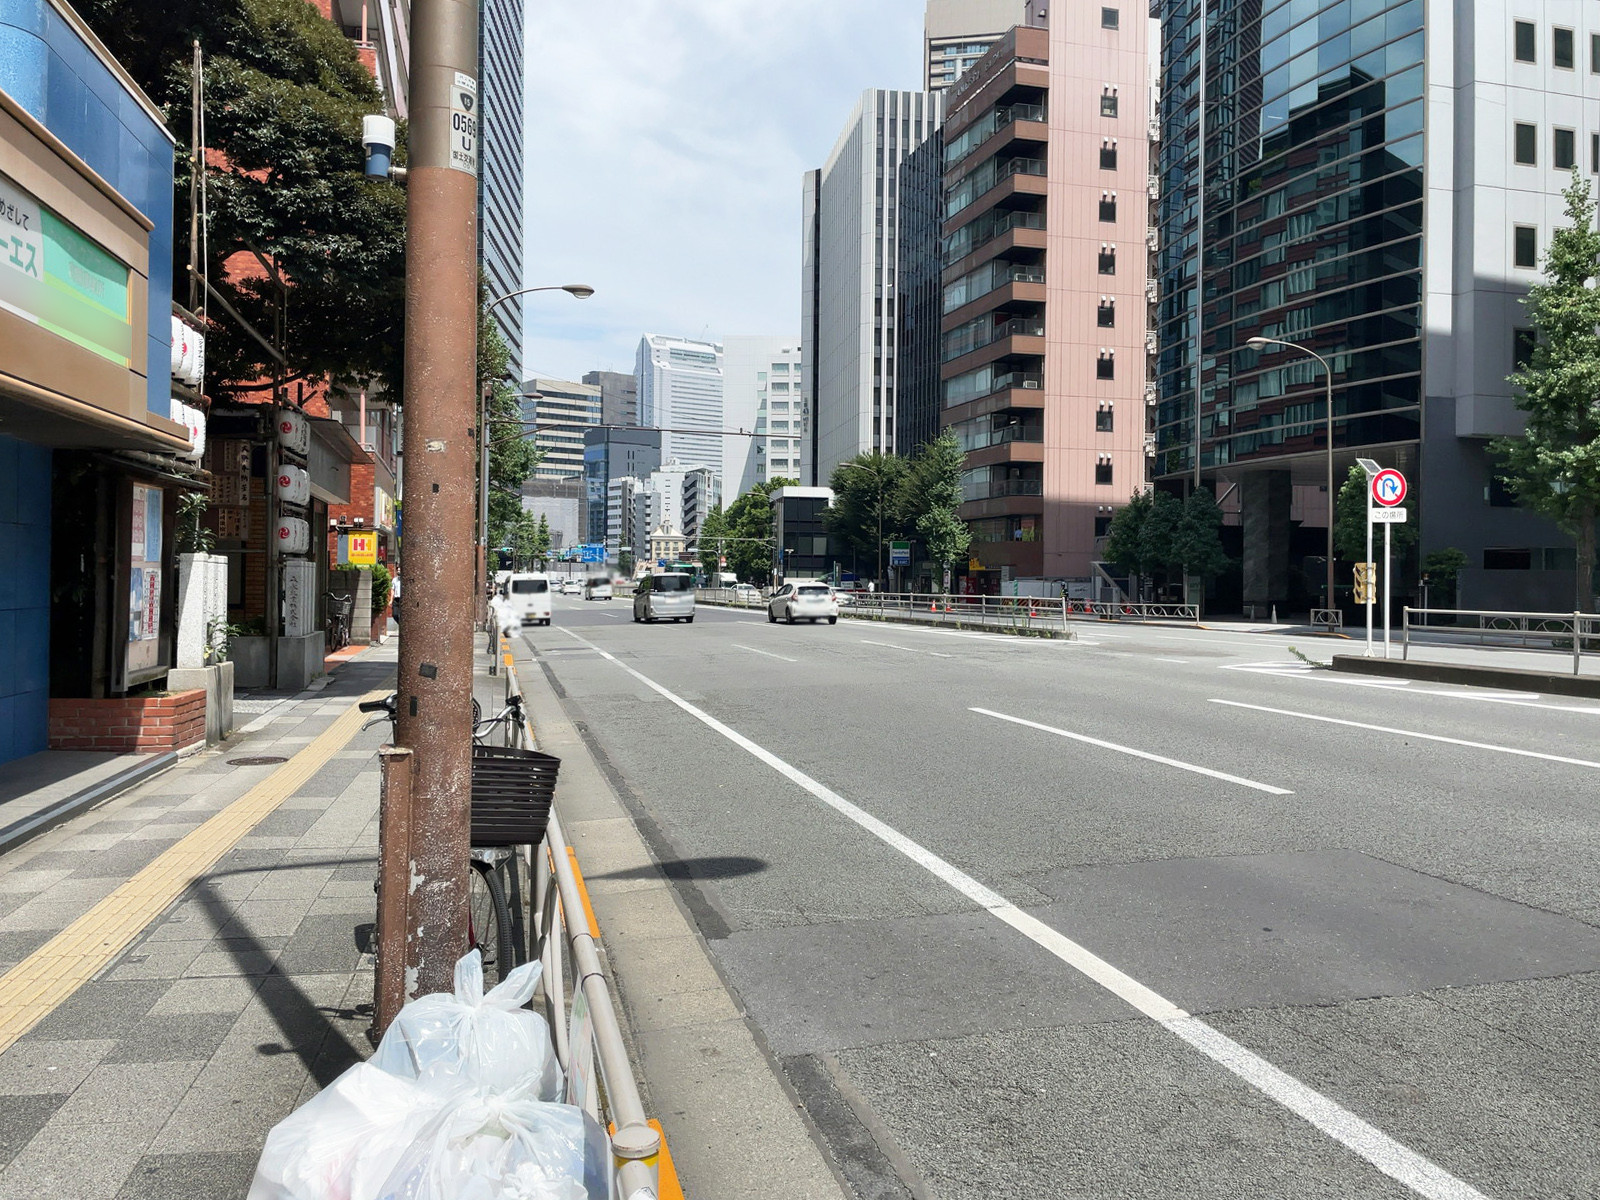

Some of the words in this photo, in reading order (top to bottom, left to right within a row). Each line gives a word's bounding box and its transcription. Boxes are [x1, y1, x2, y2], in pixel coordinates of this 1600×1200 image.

[462, 136, 471, 151] U
[0, 197, 29, 231] めざして
[1374, 511, 1404, 519] この場所
